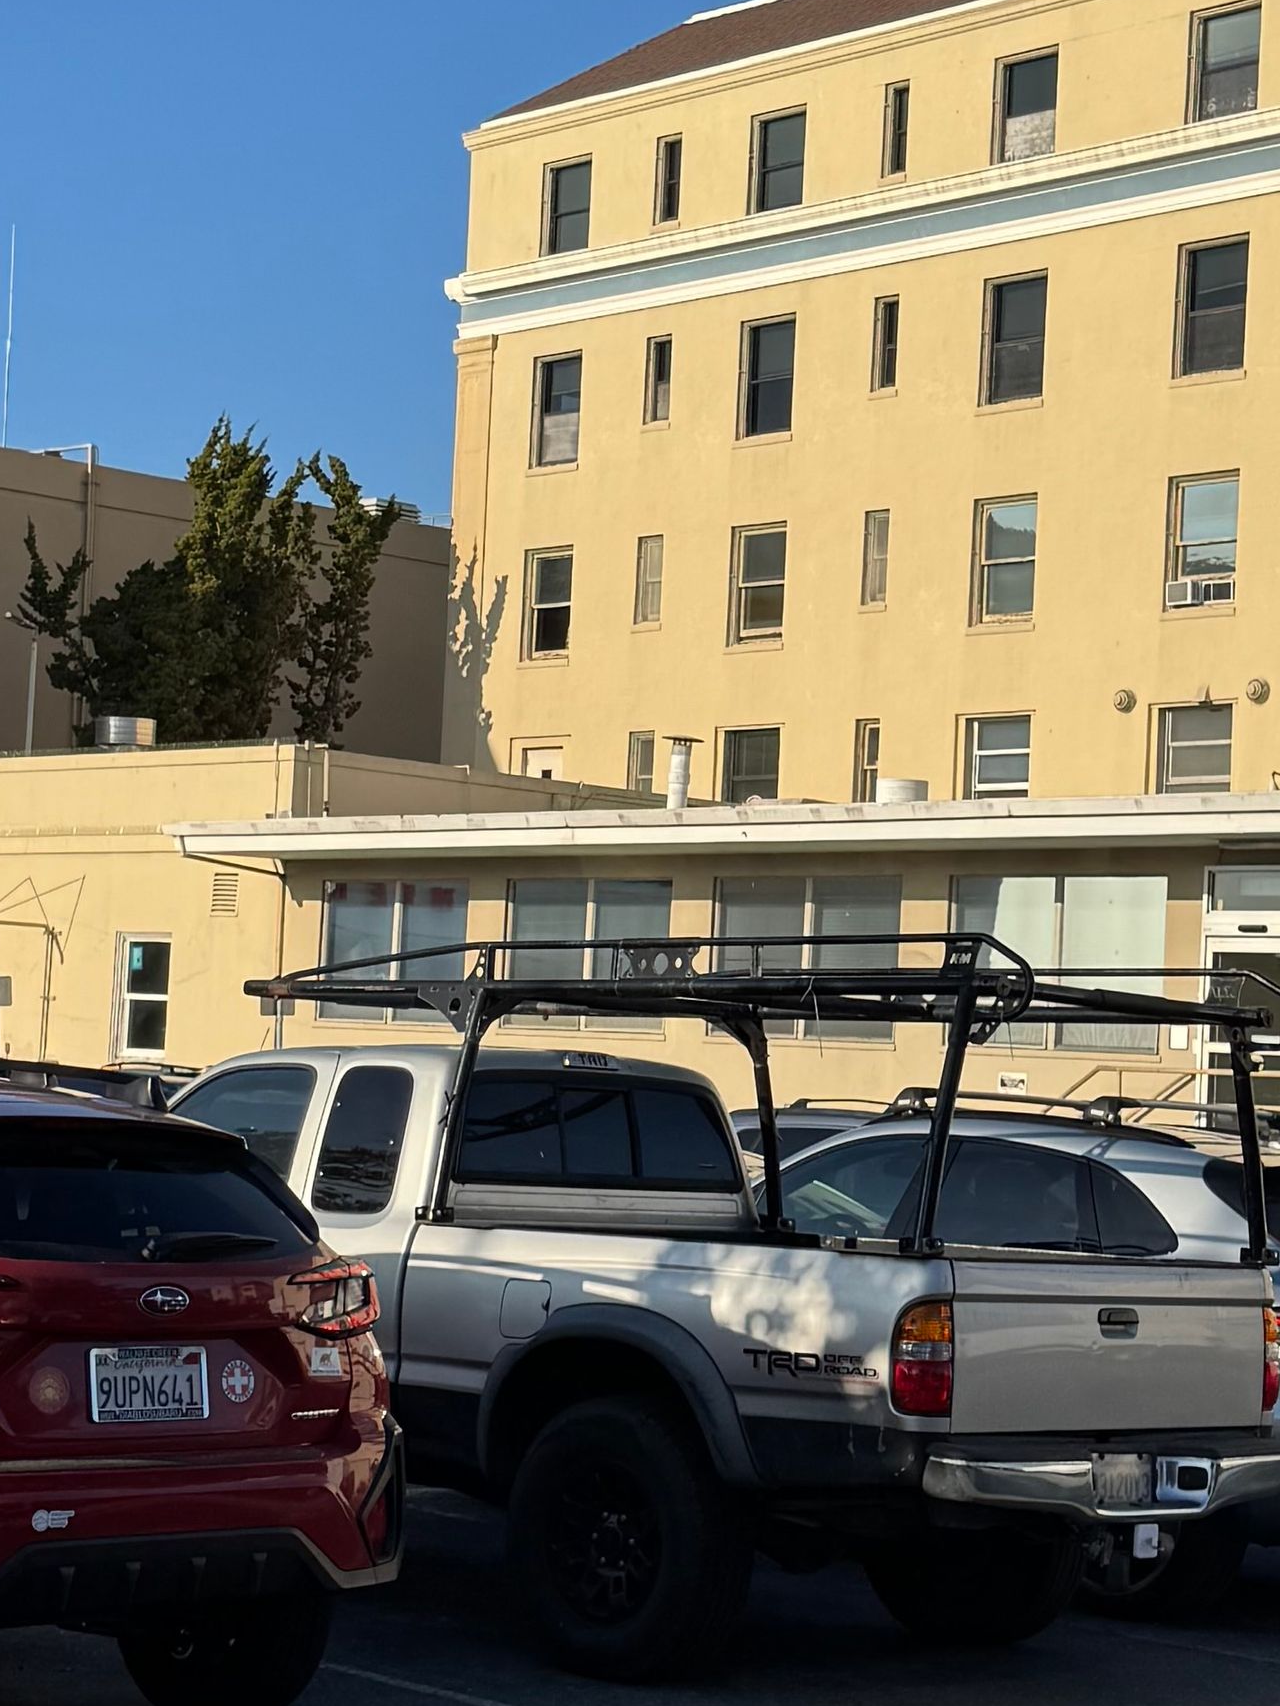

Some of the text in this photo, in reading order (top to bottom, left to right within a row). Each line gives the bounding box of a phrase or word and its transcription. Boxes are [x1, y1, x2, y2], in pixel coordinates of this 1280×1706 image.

[742, 1348, 821, 1377] TRD
[823, 1354, 863, 1366] OFF
[823, 1365, 878, 1379] ROAD
[99, 1374, 199, 1409] 9UPN641
